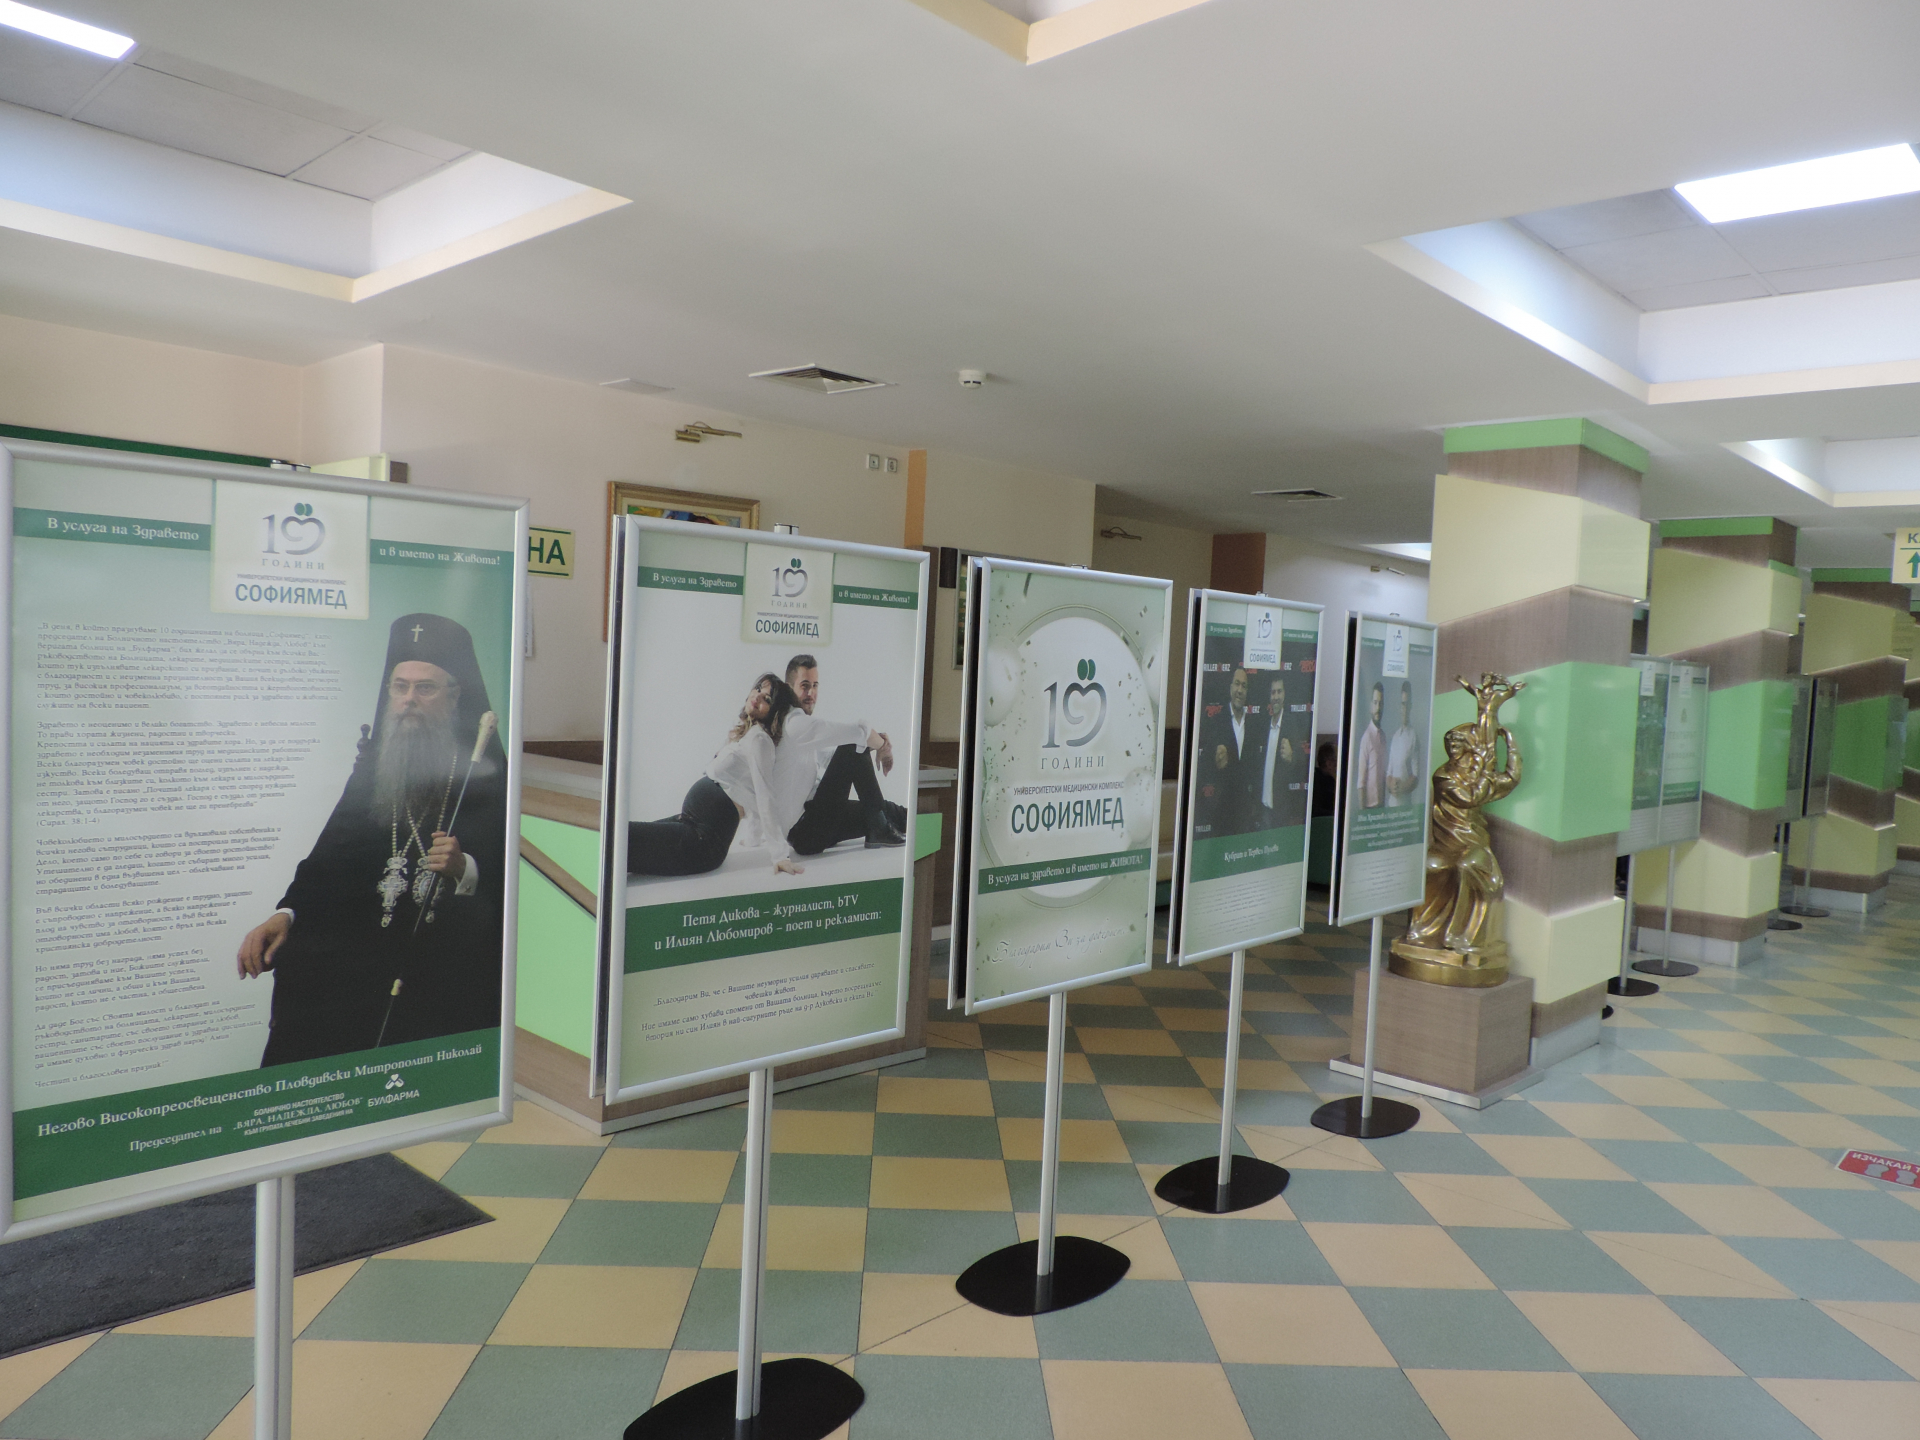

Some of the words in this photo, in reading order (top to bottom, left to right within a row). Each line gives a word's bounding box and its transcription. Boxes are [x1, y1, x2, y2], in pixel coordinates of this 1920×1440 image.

[62, 520, 107, 536] услуга
[111, 524, 127, 535] на
[133, 522, 201, 541] Здравето
[261, 557, 325, 570] ГОДИНИ
[398, 548, 435, 559] името
[437, 552, 450, 560] на
[660, 575, 686, 586] услуга
[687, 577, 697, 585] на
[700, 575, 737, 589] Здравето
[234, 582, 348, 610] СОФИЯМЕД
[849, 592, 871, 600] името
[755, 618, 820, 638] СОФИЯМЕД
[1041, 755, 1105, 770] ГОДИНИ
[1013, 784, 1061, 795] УНИВЕРСИТЕТСКИ
[1062, 782, 1097, 792] МЕДИЦИНСКИ
[1098, 781, 1124, 790] КОМПЛЕКС
[1011, 797, 1124, 834] СОФИЯМЕД
[995, 873, 1018, 885] услуга
[1020, 871, 1029, 880] на
[1031, 865, 1064, 880] здравето
[1077, 862, 1099, 872] името
[682, 914, 716, 927] Петя
[719, 906, 760, 922] Дикова
[837, 893, 859, 906] bTV
[665, 935, 702, 948] Илиян
[706, 922, 773, 943] Любомиров
[785, 920, 813, 932] поет
[36, 1114, 95, 1137] Негово
[100, 1081, 271, 1125] Високопреосвещенство
[275, 1067, 350, 1092] Пловдивски
[354, 1054, 433, 1077] Митрополит
[436, 1041, 482, 1061] Николай
[367, 1088, 420, 1107] БУЛФАРМА
[253, 1102, 291, 1116] БОЛНИЧНО
[292, 1092, 345, 1108] НАСТОЯТЕЛСТВО
[129, 1127, 206, 1153] Председател
[208, 1124, 222, 1136] на
[1852, 1152, 1912, 1171] ИЗЧАКАЙ
